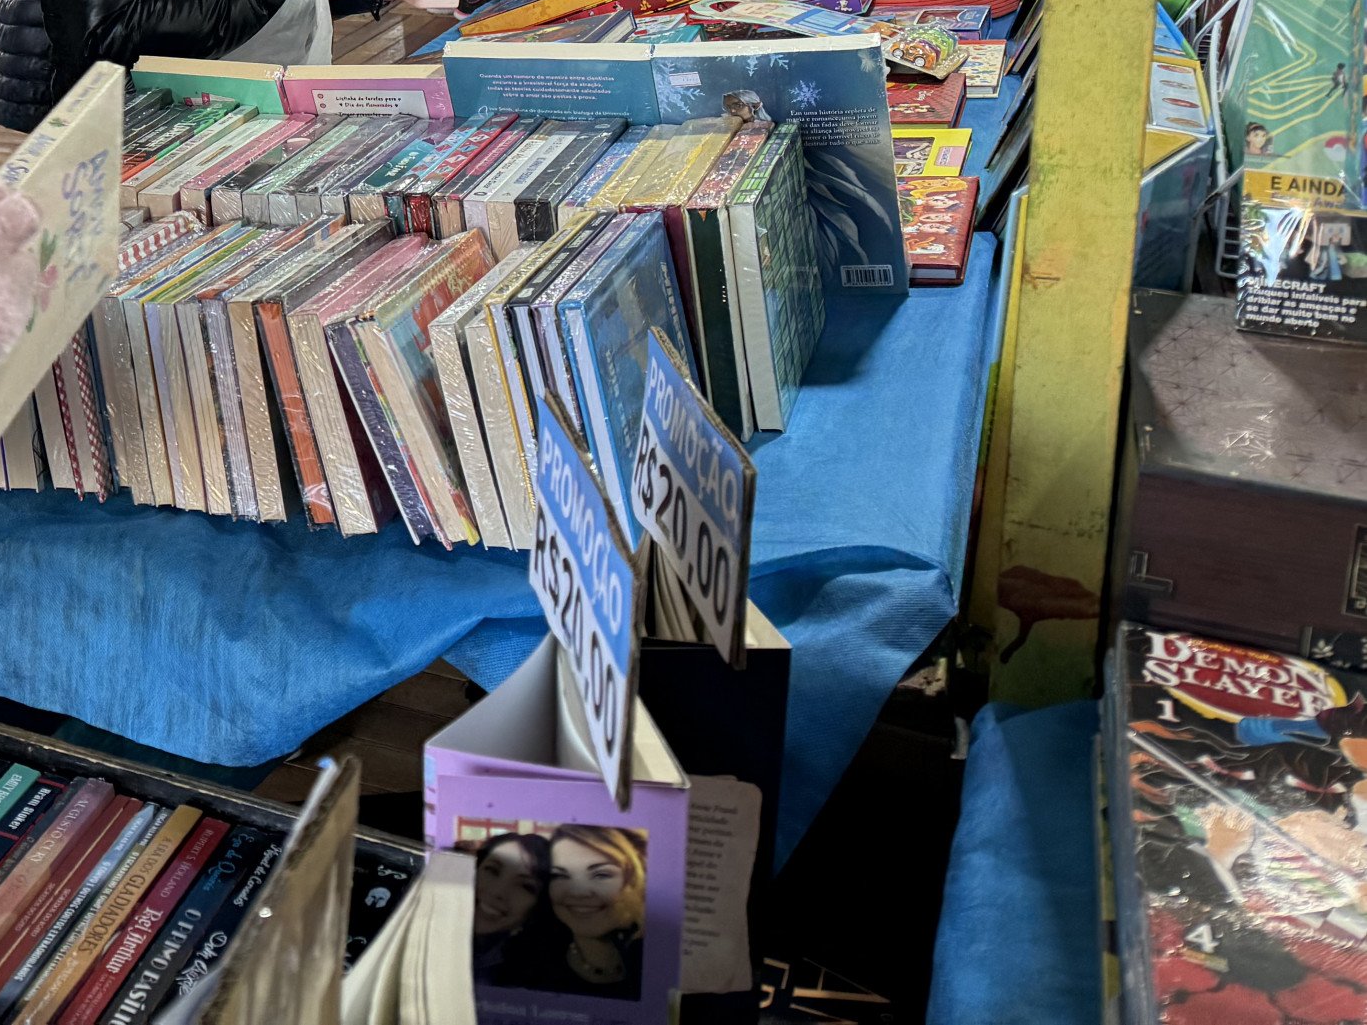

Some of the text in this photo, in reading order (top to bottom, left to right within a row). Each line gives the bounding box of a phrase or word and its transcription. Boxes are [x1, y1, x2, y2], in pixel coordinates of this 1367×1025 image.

[1271, 176, 1281, 190] E
[1245, 313, 1320, 328] mundo aberto
[1246, 296, 1281, 307] driblar
[1299, 302, 1347, 314] ameaças
[1349, 307, 1357, 315] e
[1246, 304, 1355, 323] se dar muito bem no
[1292, 291, 1339, 304] infalíveis
[1342, 298, 1367, 307] para
[649, 363, 740, 522] PROMOÇÃO
[543, 425, 622, 635] PROMOÇÃO
[1145, 631, 1329, 694] DEMON
[1142, 659, 1334, 719] SLAYER
[1157, 699, 1180, 723] 1
[7, 784, 51, 831] Bram Stoker
[29, 794, 88, 865] AUGUSTO CURY
[77, 869, 145, 958] GLADIADORES
[1185, 923, 1218, 954] 4
[105, 901, 162, 978] Rei Arthur
[149, 917, 192, 973] PRIMO
